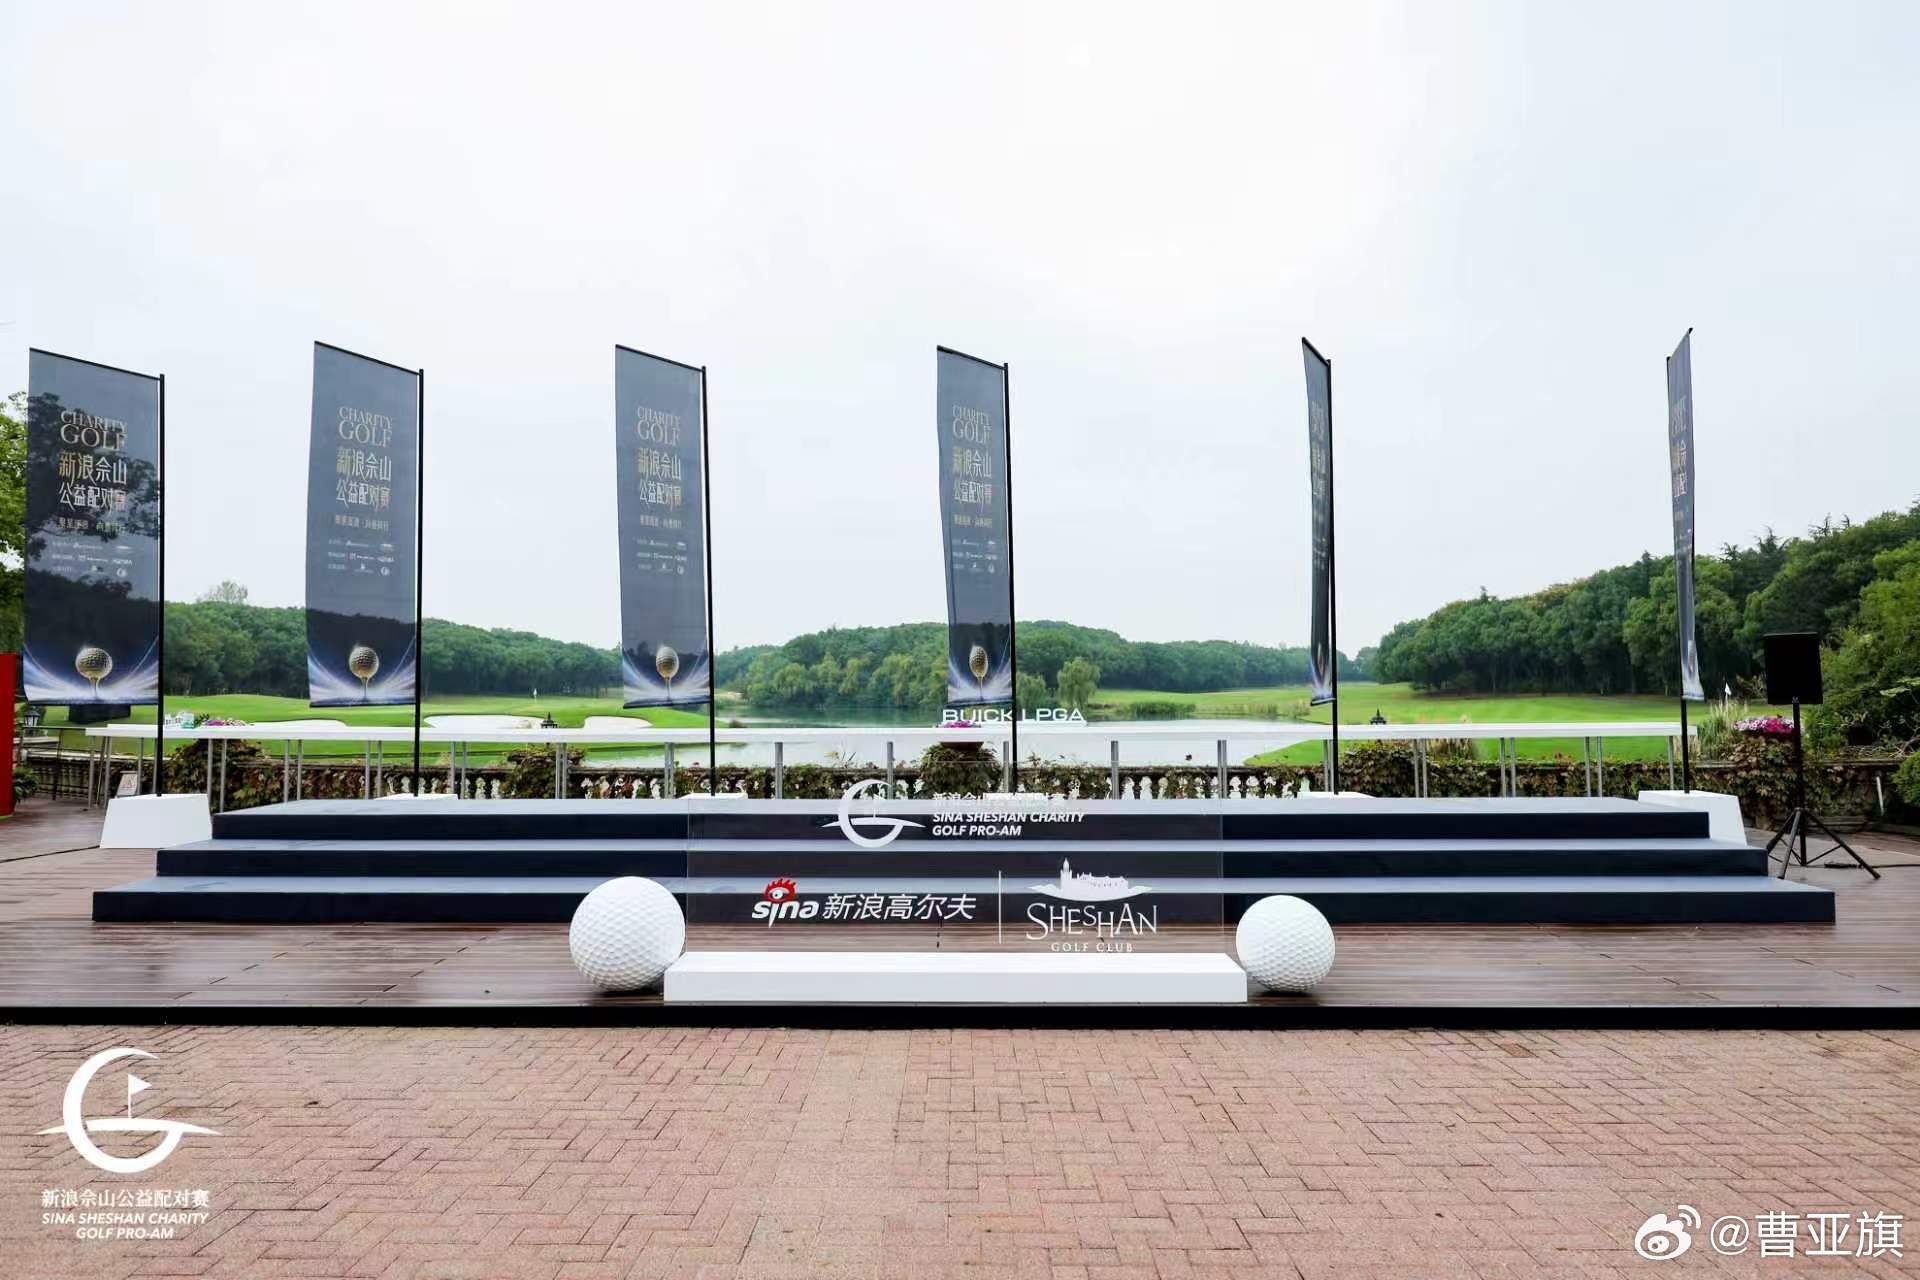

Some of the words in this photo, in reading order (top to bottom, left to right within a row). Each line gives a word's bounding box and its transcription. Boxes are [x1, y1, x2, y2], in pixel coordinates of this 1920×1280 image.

[60, 410, 128, 433] CHARITY
[338, 406, 393, 429] CHARITY
[60, 424, 128, 451] GOLF
[338, 420, 392, 447] GOLF
[637, 420, 681, 446] GOLF
[952, 418, 992, 444] GOLF
[58, 451, 128, 486] 新浪佘山
[942, 708, 1013, 723] BUICK
[1021, 707, 1086, 722] LPGA
[932, 812, 963, 823] SINA
[966, 812, 1026, 823] SHESHAN
[1029, 812, 1085, 823] CHARITY
[932, 825, 967, 836] GOLF
[969, 825, 1022, 836] PRO-AM
[822, 892, 977, 921] 新浪高尔夫
[1051, 942, 1089, 953] GOLF
[1096, 942, 1133, 953] CLUB
